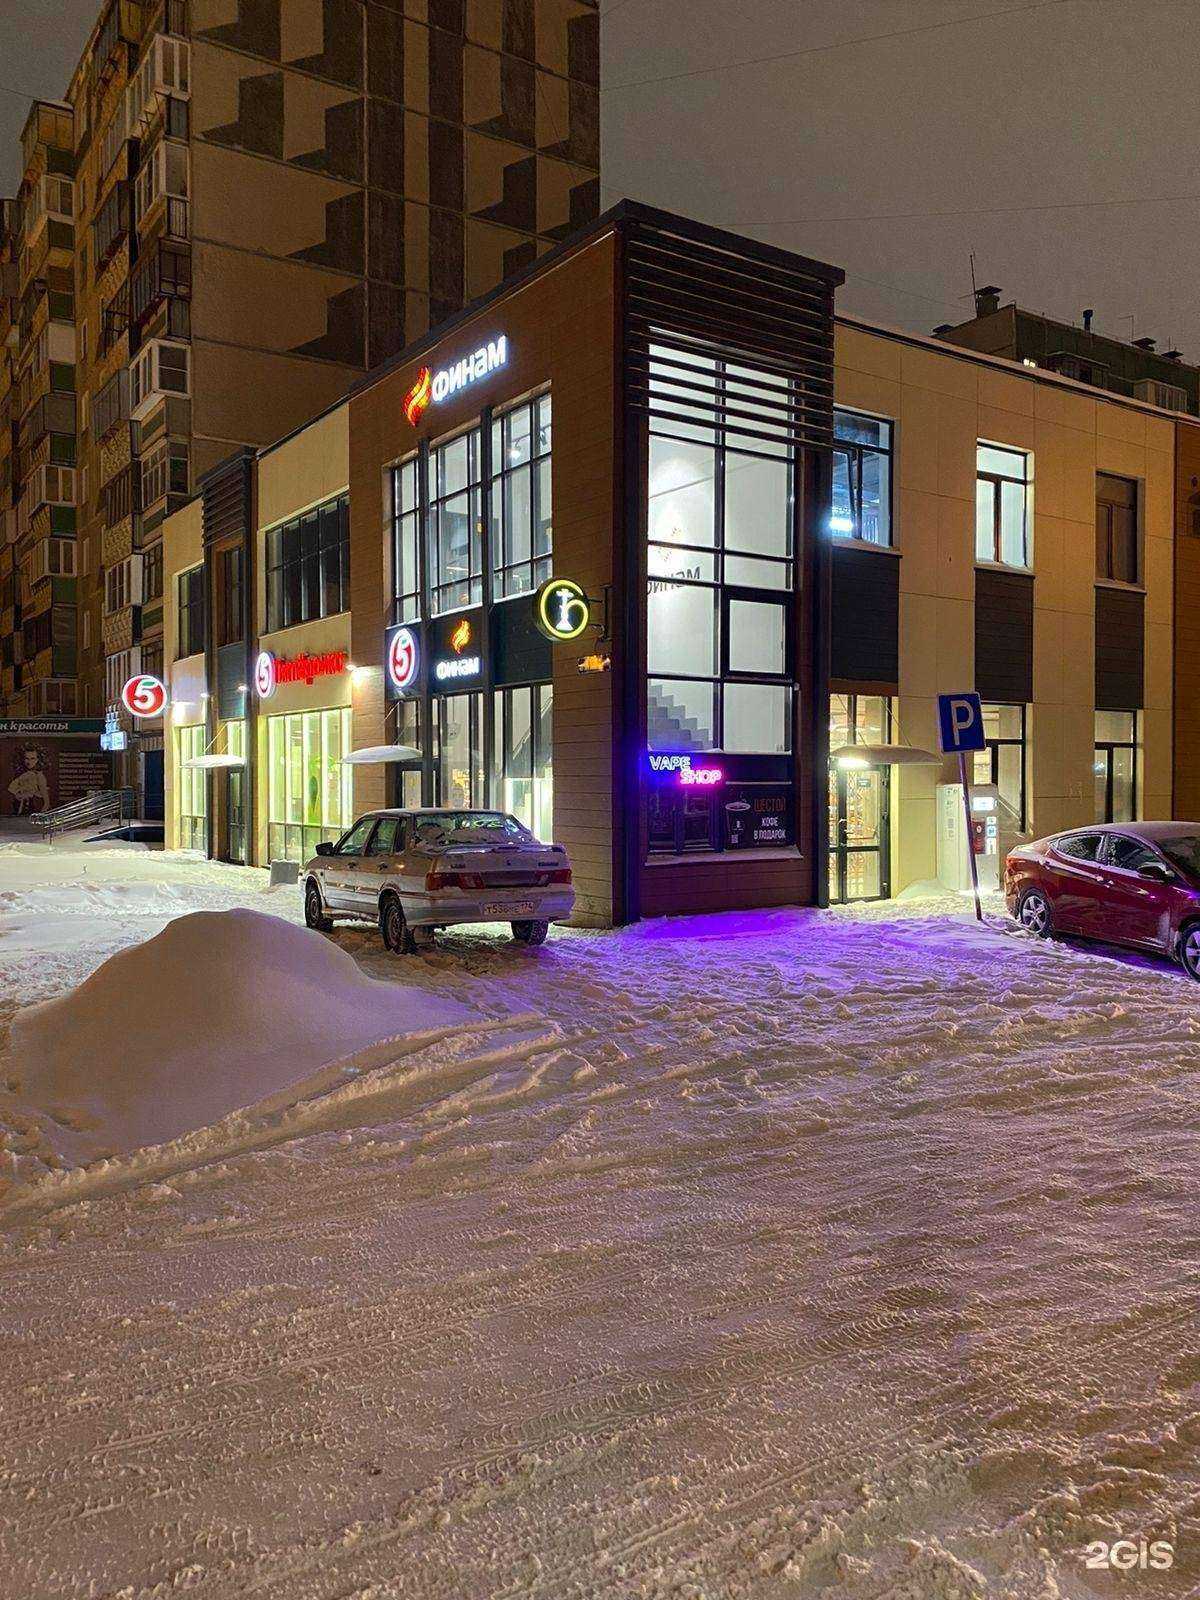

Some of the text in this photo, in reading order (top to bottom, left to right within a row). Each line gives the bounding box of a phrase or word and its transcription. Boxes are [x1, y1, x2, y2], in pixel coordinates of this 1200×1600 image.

[133, 677, 160, 710] 5
[10, 720, 69, 733] красоты
[950, 699, 974, 746] P
[649, 756, 691, 771] VAPE
[679, 769, 722, 785] SHOP
[761, 817, 779, 827] КОФЕ
[758, 829, 786, 840] ПОДАРОК
